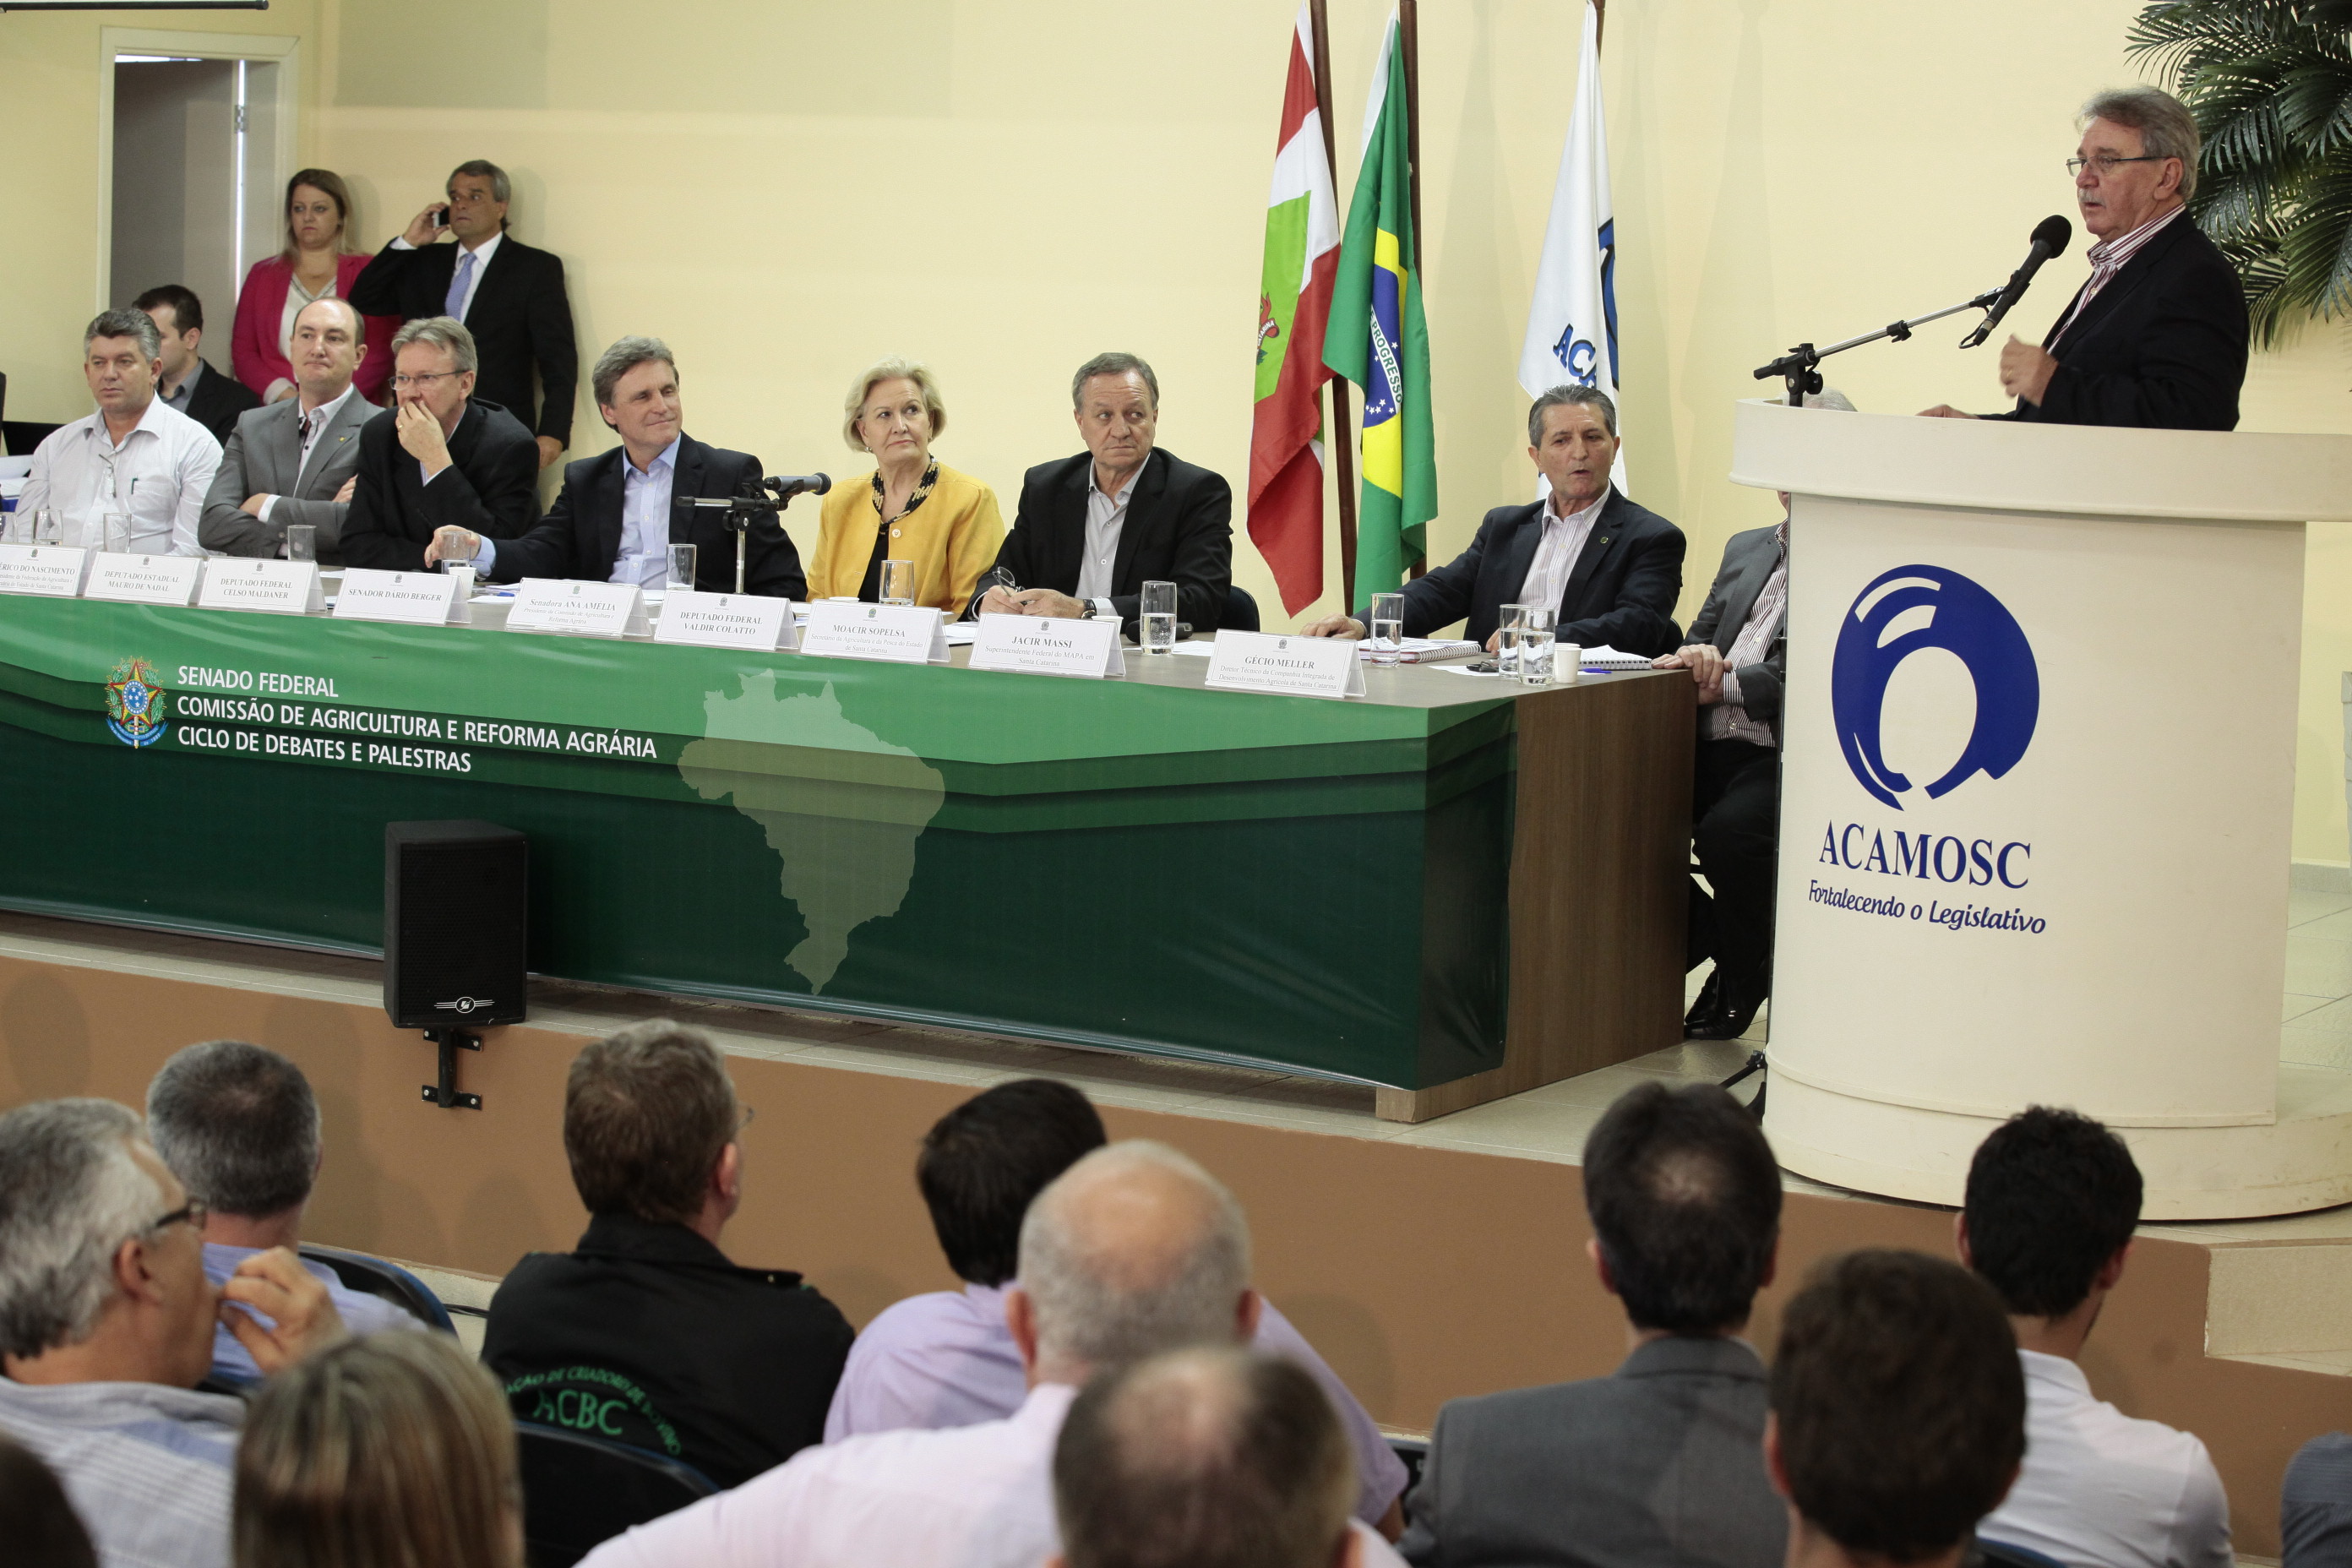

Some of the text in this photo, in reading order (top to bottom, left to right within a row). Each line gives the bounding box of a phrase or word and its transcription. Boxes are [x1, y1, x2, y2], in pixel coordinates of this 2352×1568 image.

[1371, 320, 1402, 404] PROGRESSO
[31, 565, 75, 575] NASCIMENTO
[105, 570, 180, 583] DEPUTADO ESTADUAL
[109, 580, 134, 590] MAURO
[220, 578, 292, 589] DEPUTADO FEDERAL
[223, 588, 288, 599] CELSO MALDANER
[348, 588, 442, 601] SENADOR DÁRIO BERGER
[530, 598, 615, 611] Senadora ANA AMÉLIA
[680, 612, 762, 624] DEPUTADO FEDERAL
[684, 623, 756, 635] VALDIR COLATTO
[832, 624, 906, 638] MOACIR SOPELSA
[1011, 635, 1072, 649] JACIR MASSI
[985, 645, 1031, 656] Superintendente
[1032, 649, 1054, 657] Federal
[1063, 651, 1084, 660] MAPA
[1244, 654, 1315, 669] GÉCIO MELLER
[1240, 666, 1261, 675] Técnico
[1270, 669, 1301, 678] Companhia
[1302, 672, 1328, 681] Integrada
[177, 665, 340, 698] SENADO FEDERAL
[1218, 674, 1265, 683] Desenvolvimento
[1314, 681, 1337, 690] Catarina
[177, 695, 658, 759] COMISSÃO DE AGRICULTURA E REFORMA AGRÁRIA
[177, 726, 230, 749] CICLO
[236, 731, 259, 752] DE
[265, 733, 346, 761] DEBATES
[351, 742, 362, 763] E
[368, 743, 471, 773] PALESTRAS
[1818, 819, 2032, 890] ACAMOSC
[1808, 879, 2047, 934] Fortalecendo o Legislativo
[532, 1388, 629, 1435] ACBC
